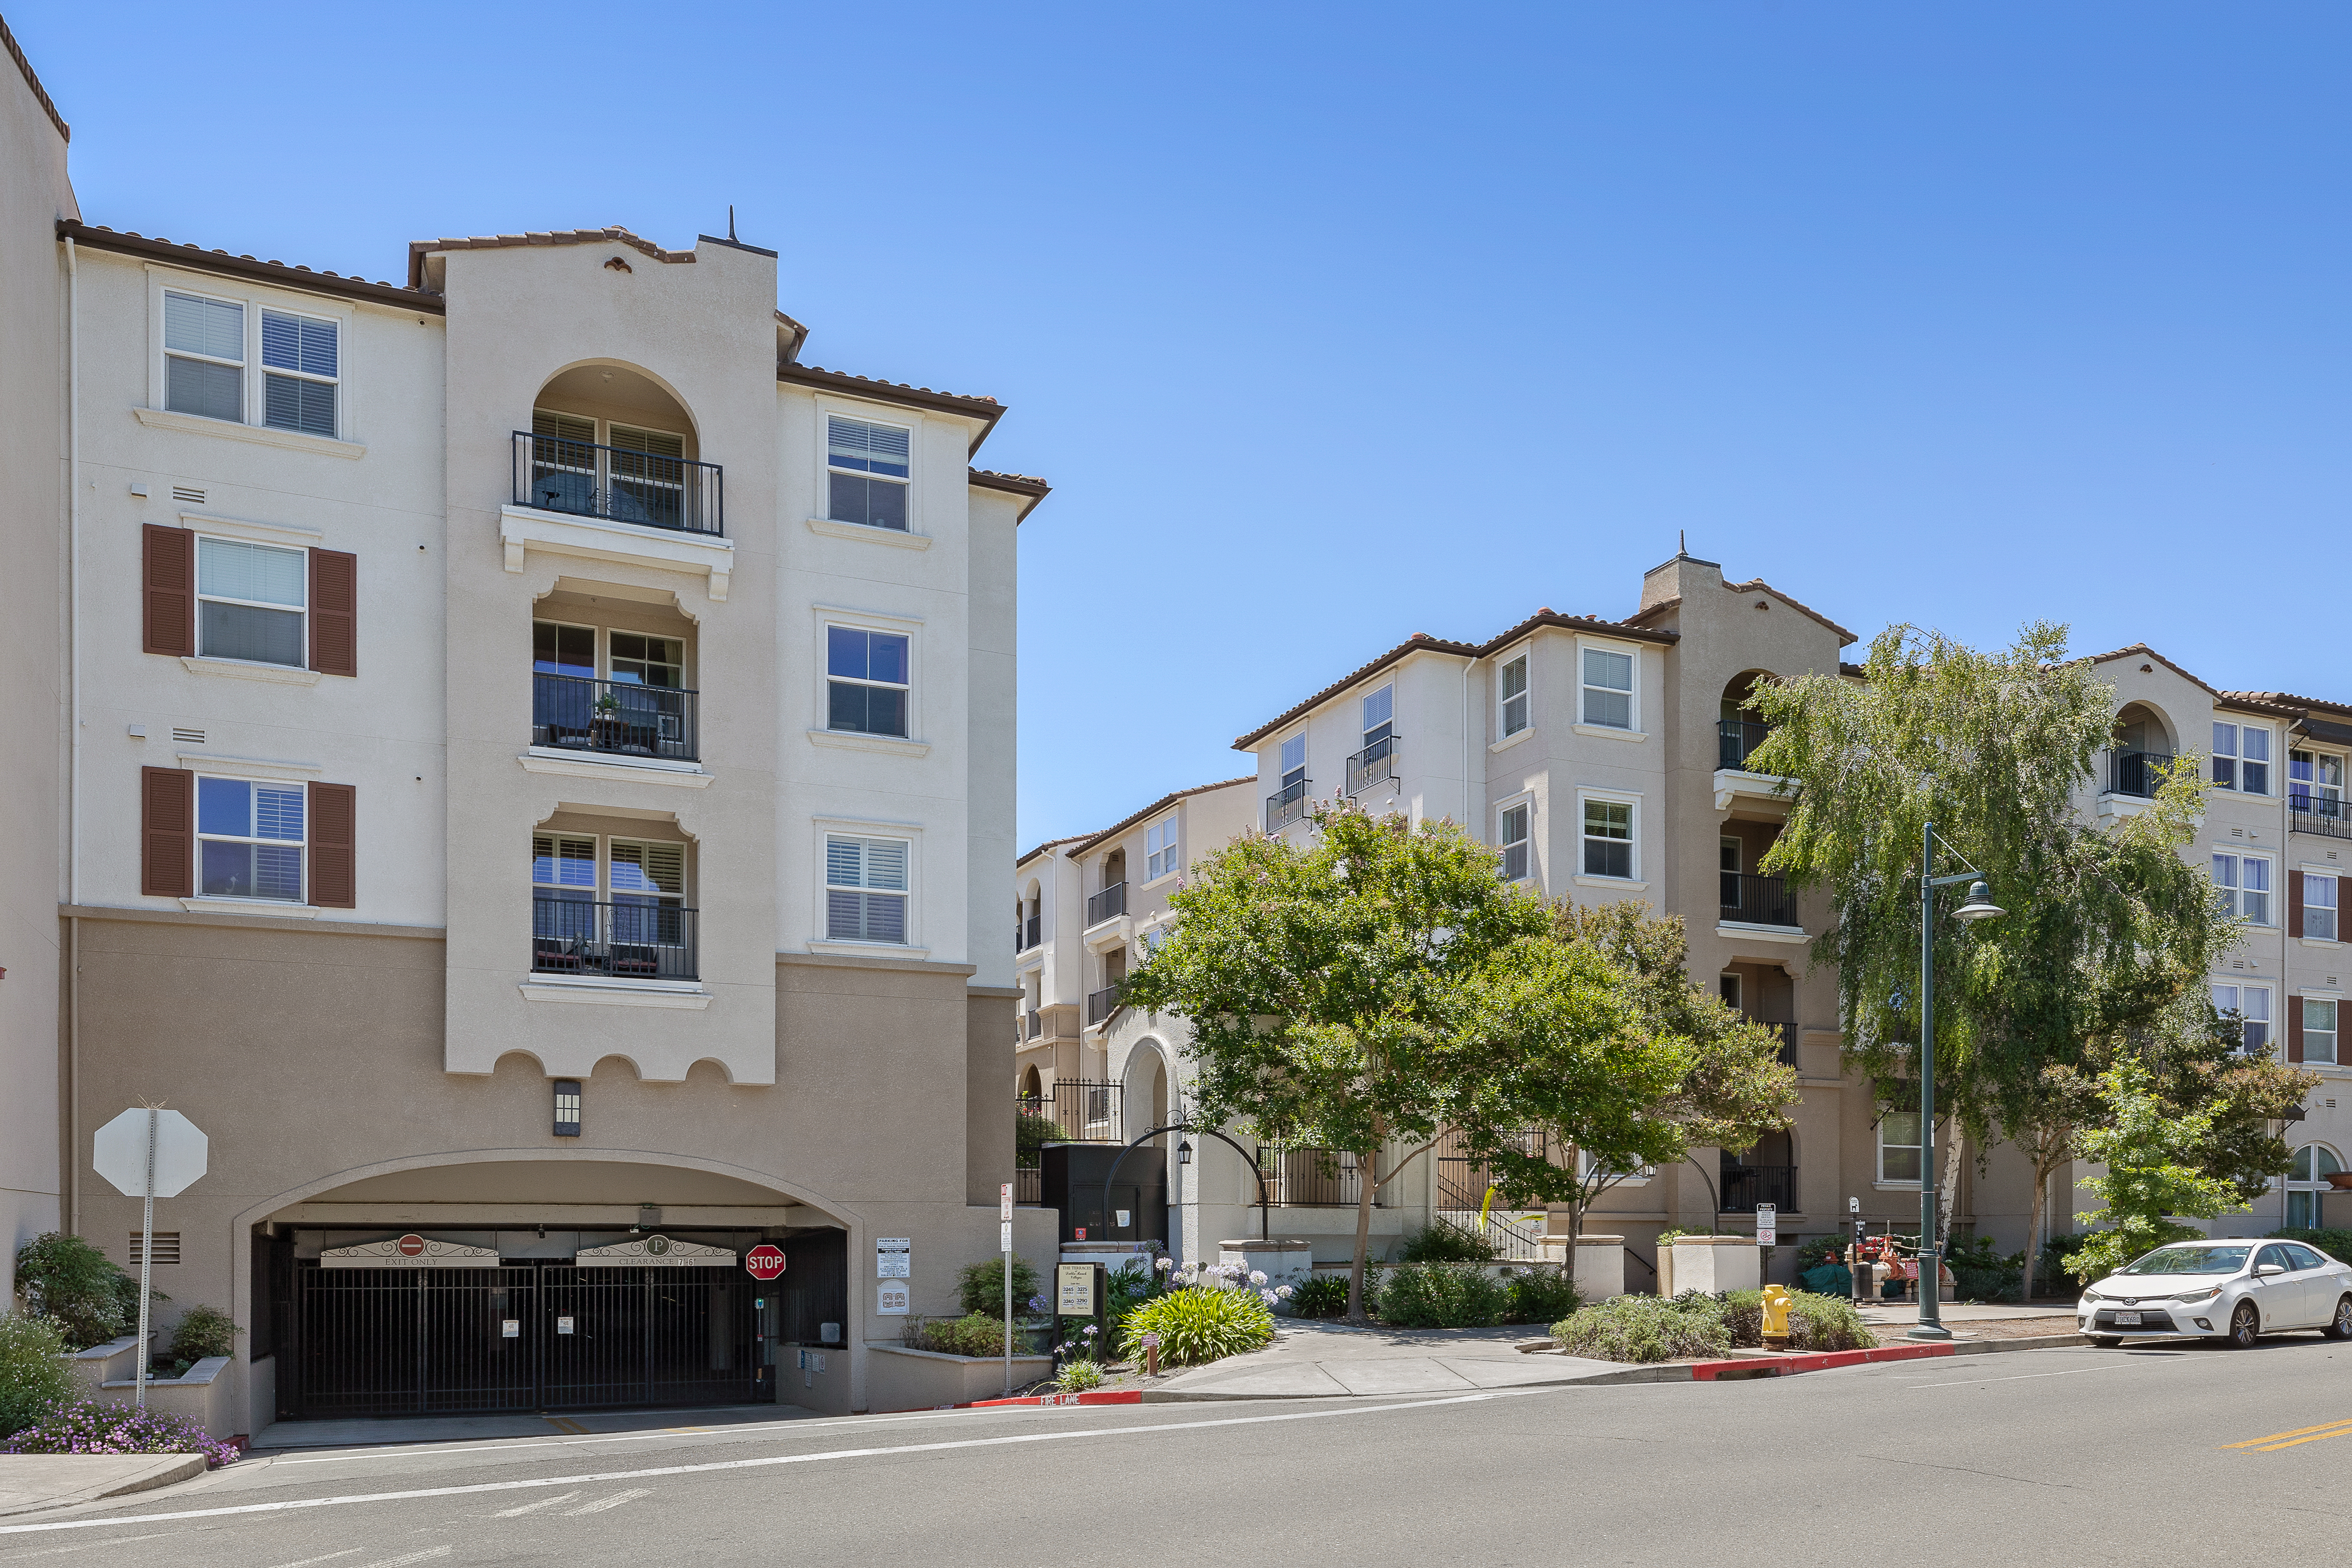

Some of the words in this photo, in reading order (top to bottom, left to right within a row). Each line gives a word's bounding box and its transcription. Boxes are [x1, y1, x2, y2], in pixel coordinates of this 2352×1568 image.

[654, 1240, 663, 1251] P
[749, 1256, 782, 1269] STOP
[1041, 1396, 1056, 1406] FIRE
[1060, 1394, 1080, 1405] LANE
